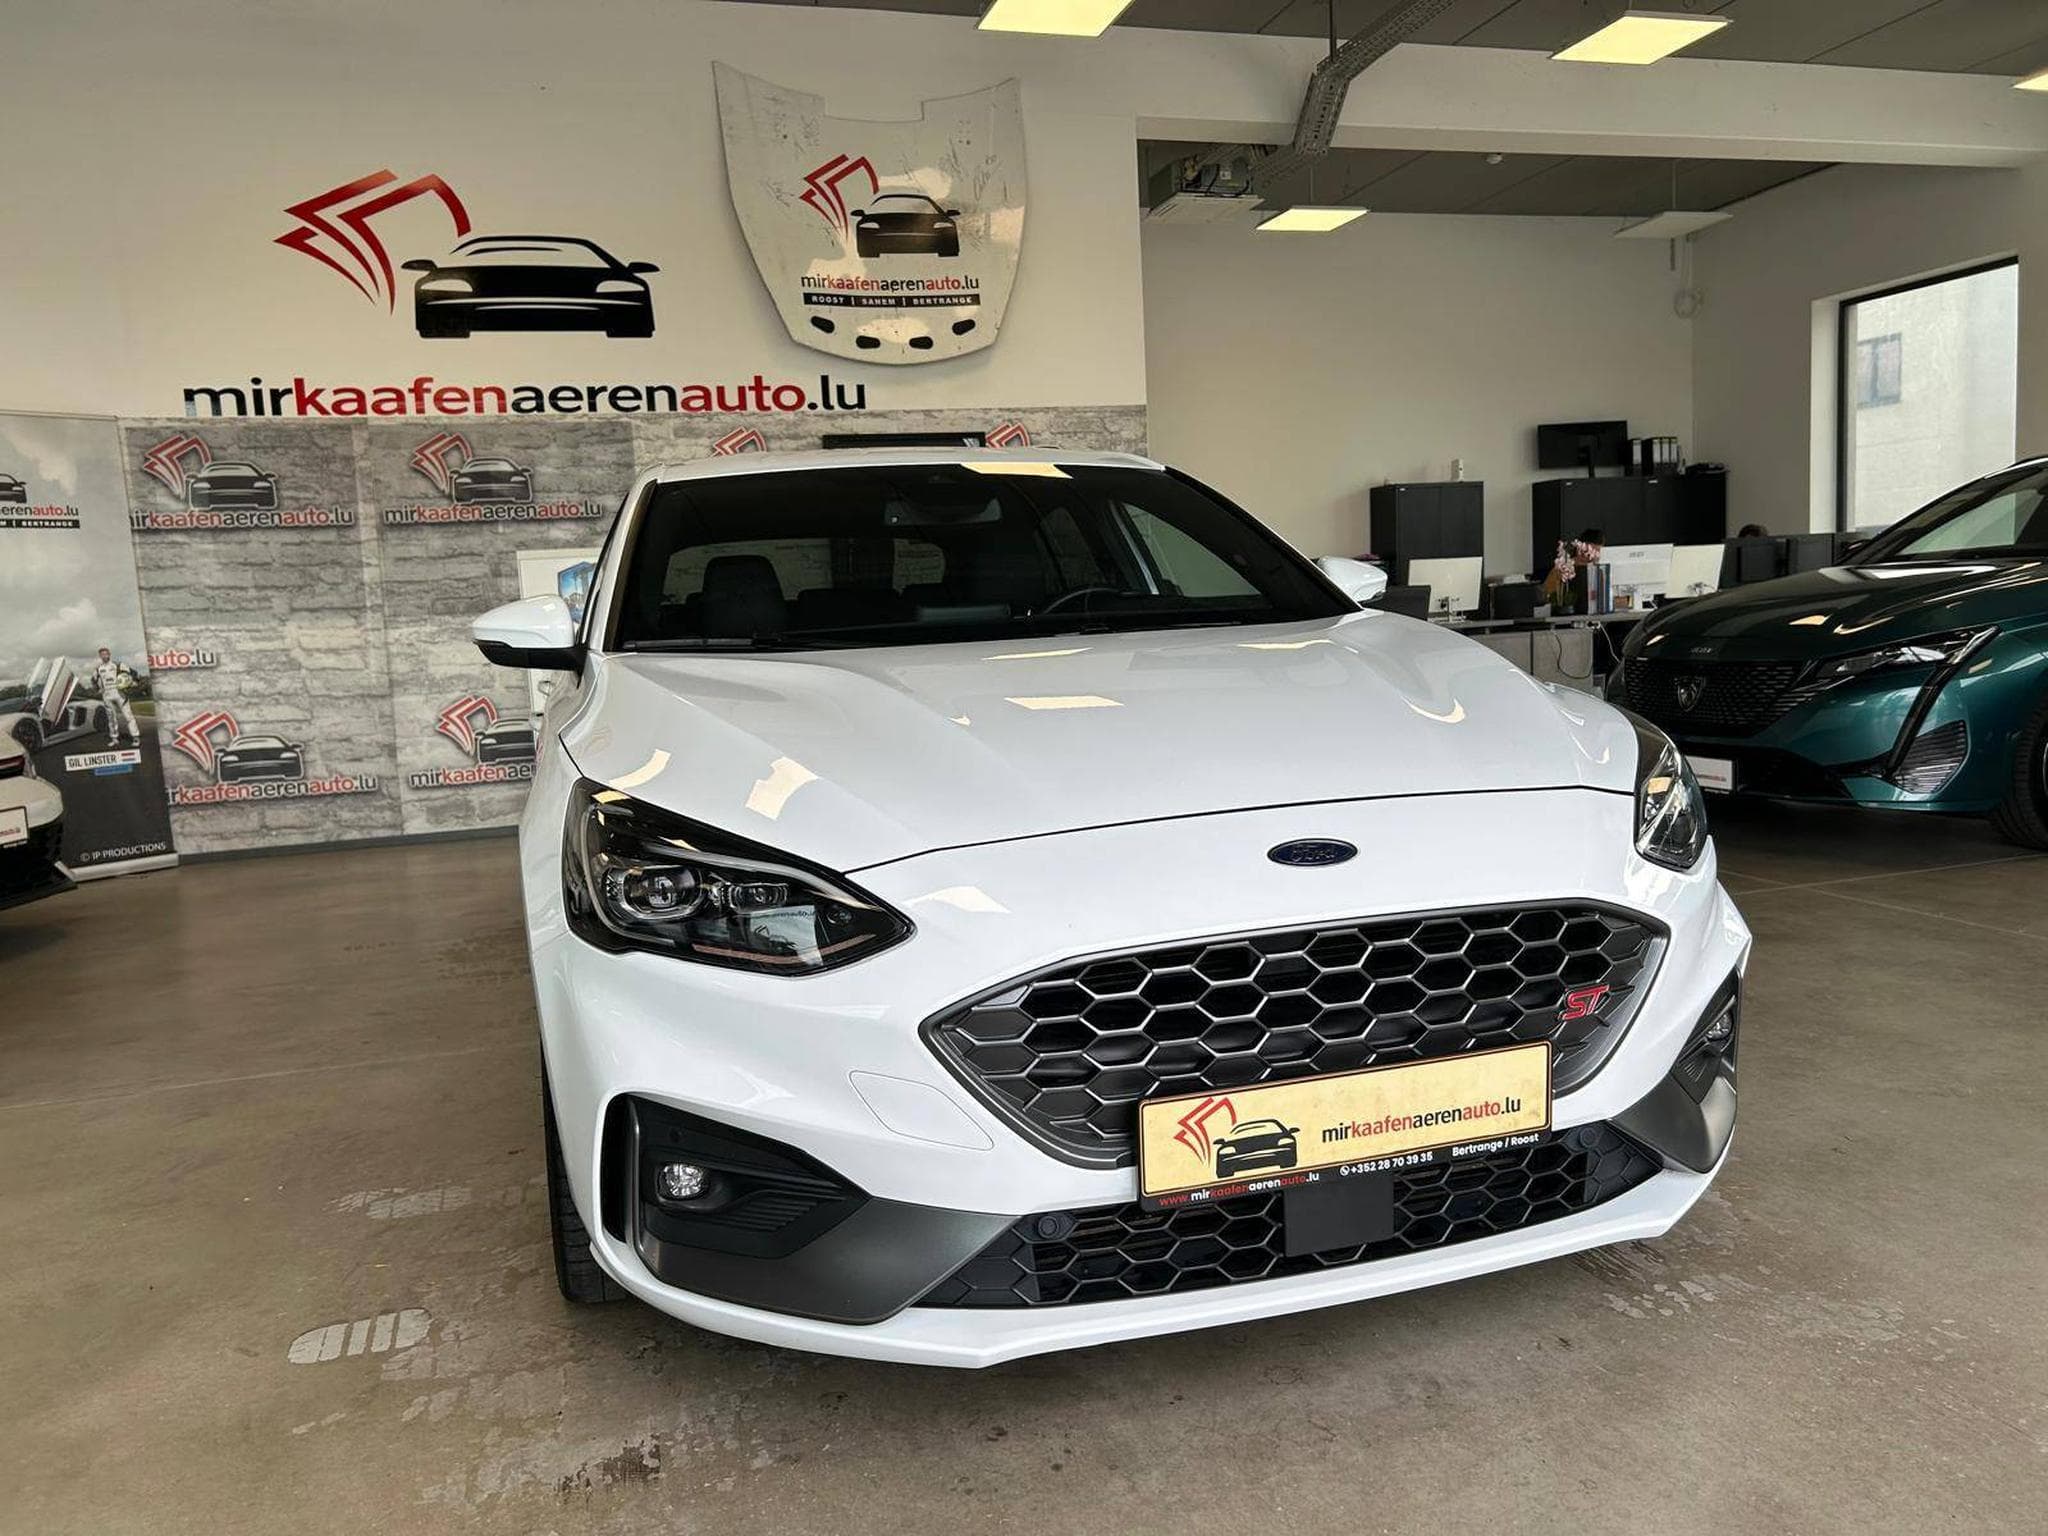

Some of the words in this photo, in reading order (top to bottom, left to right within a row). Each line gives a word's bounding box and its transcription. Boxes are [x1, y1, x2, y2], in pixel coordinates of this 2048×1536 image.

[801, 275, 980, 292] mirkaafenaerenauto.lu
[183, 374, 867, 417] mirkaafenaerenauto.lu
[0, 505, 79, 516] erenauto.lu
[130, 507, 353, 528] irkaafenaerenauto.lu
[385, 500, 602, 523] mirkaafenaerenauto.lu
[102, 841, 166, 858] PRODUCTIONS
[1562, 985, 1610, 1020] ST
[1322, 1097, 1521, 1143] mirkaafenaerenauto.lu
[1452, 1139, 1504, 1157] Bertrange
[1511, 1133, 1540, 1146] Roost
